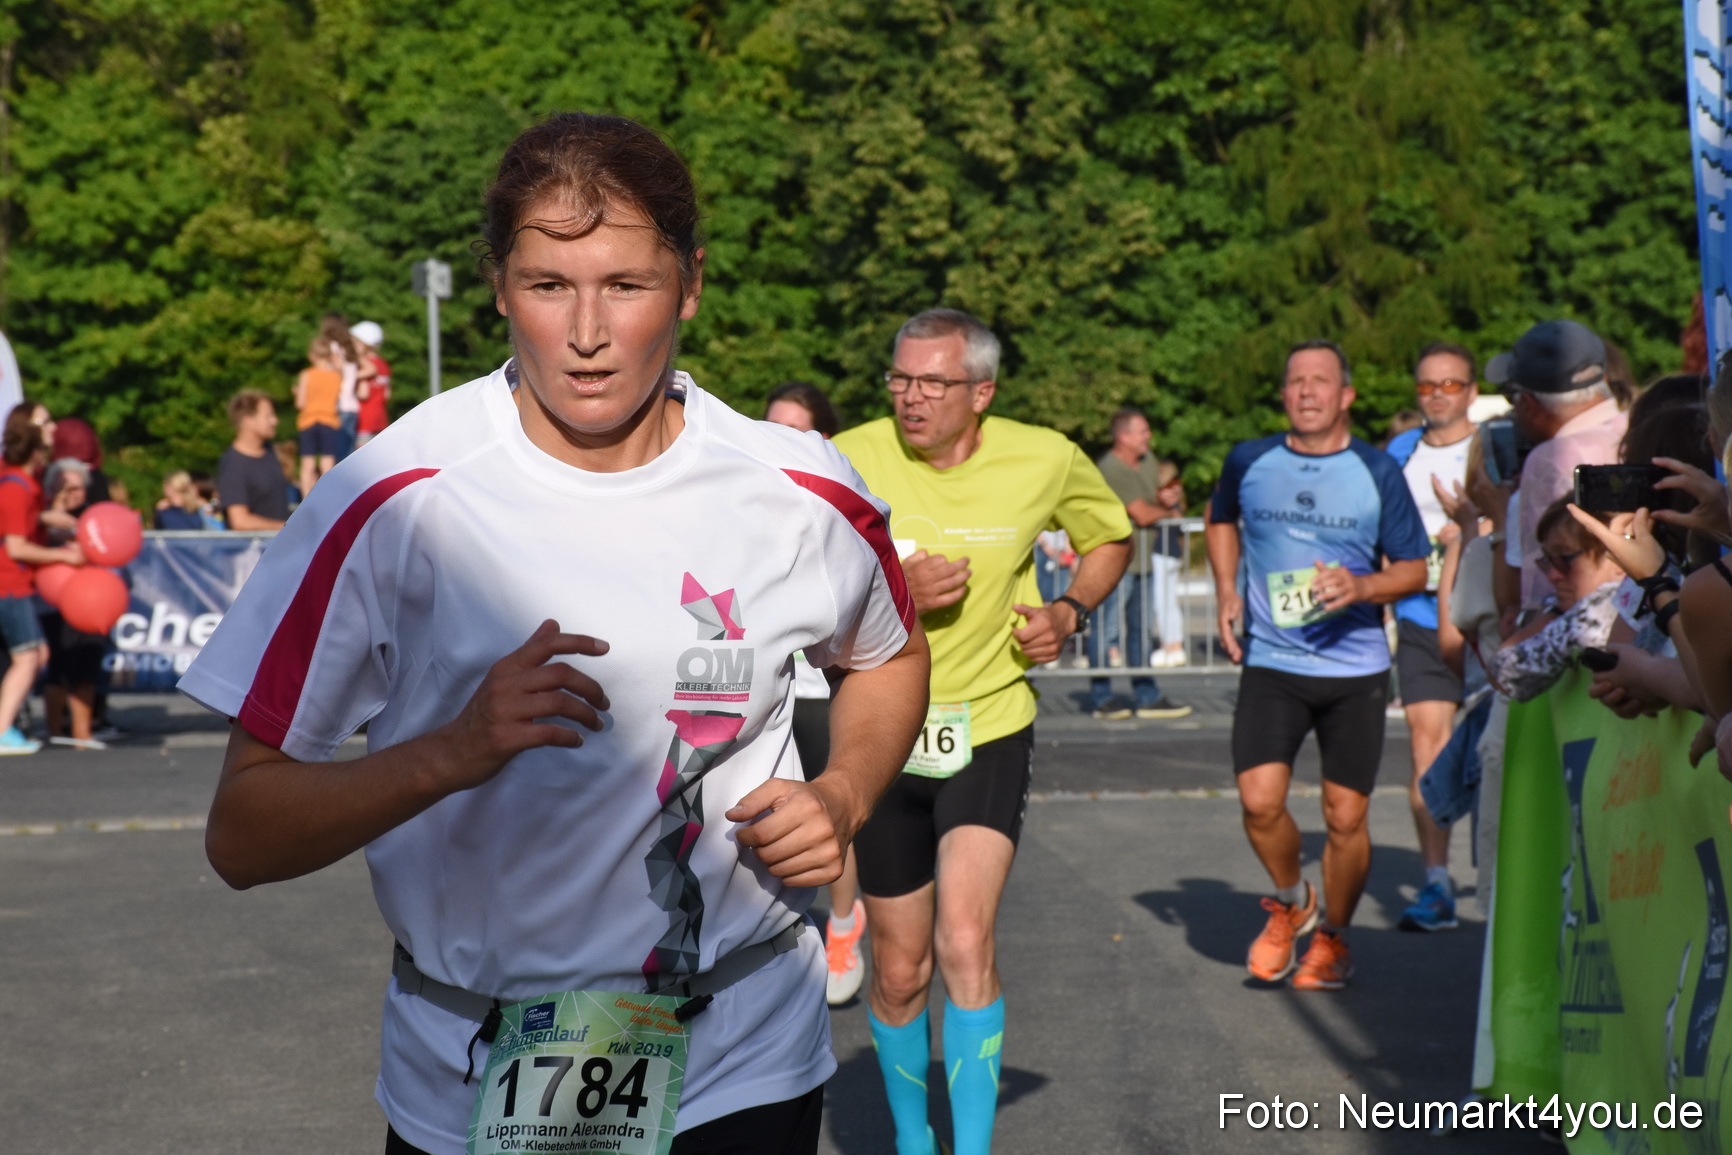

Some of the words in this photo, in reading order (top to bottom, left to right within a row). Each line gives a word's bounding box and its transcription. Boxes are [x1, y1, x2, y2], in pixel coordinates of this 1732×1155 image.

[676, 647, 754, 683] OM
[677, 682, 709, 691] KLEBE
[710, 683, 750, 692] TECHNIK
[507, 1025, 590, 1049] firmenlauf
[607, 1041, 633, 1056] run
[633, 1042, 674, 1058] 2019
[497, 1056, 649, 1119] 1784
[486, 1122, 568, 1140] Lippmann
[571, 1122, 645, 1139] Alexandra
[501, 1139, 588, 1152] OM-Klebetechnik
[589, 1139, 622, 1151] GmbH
